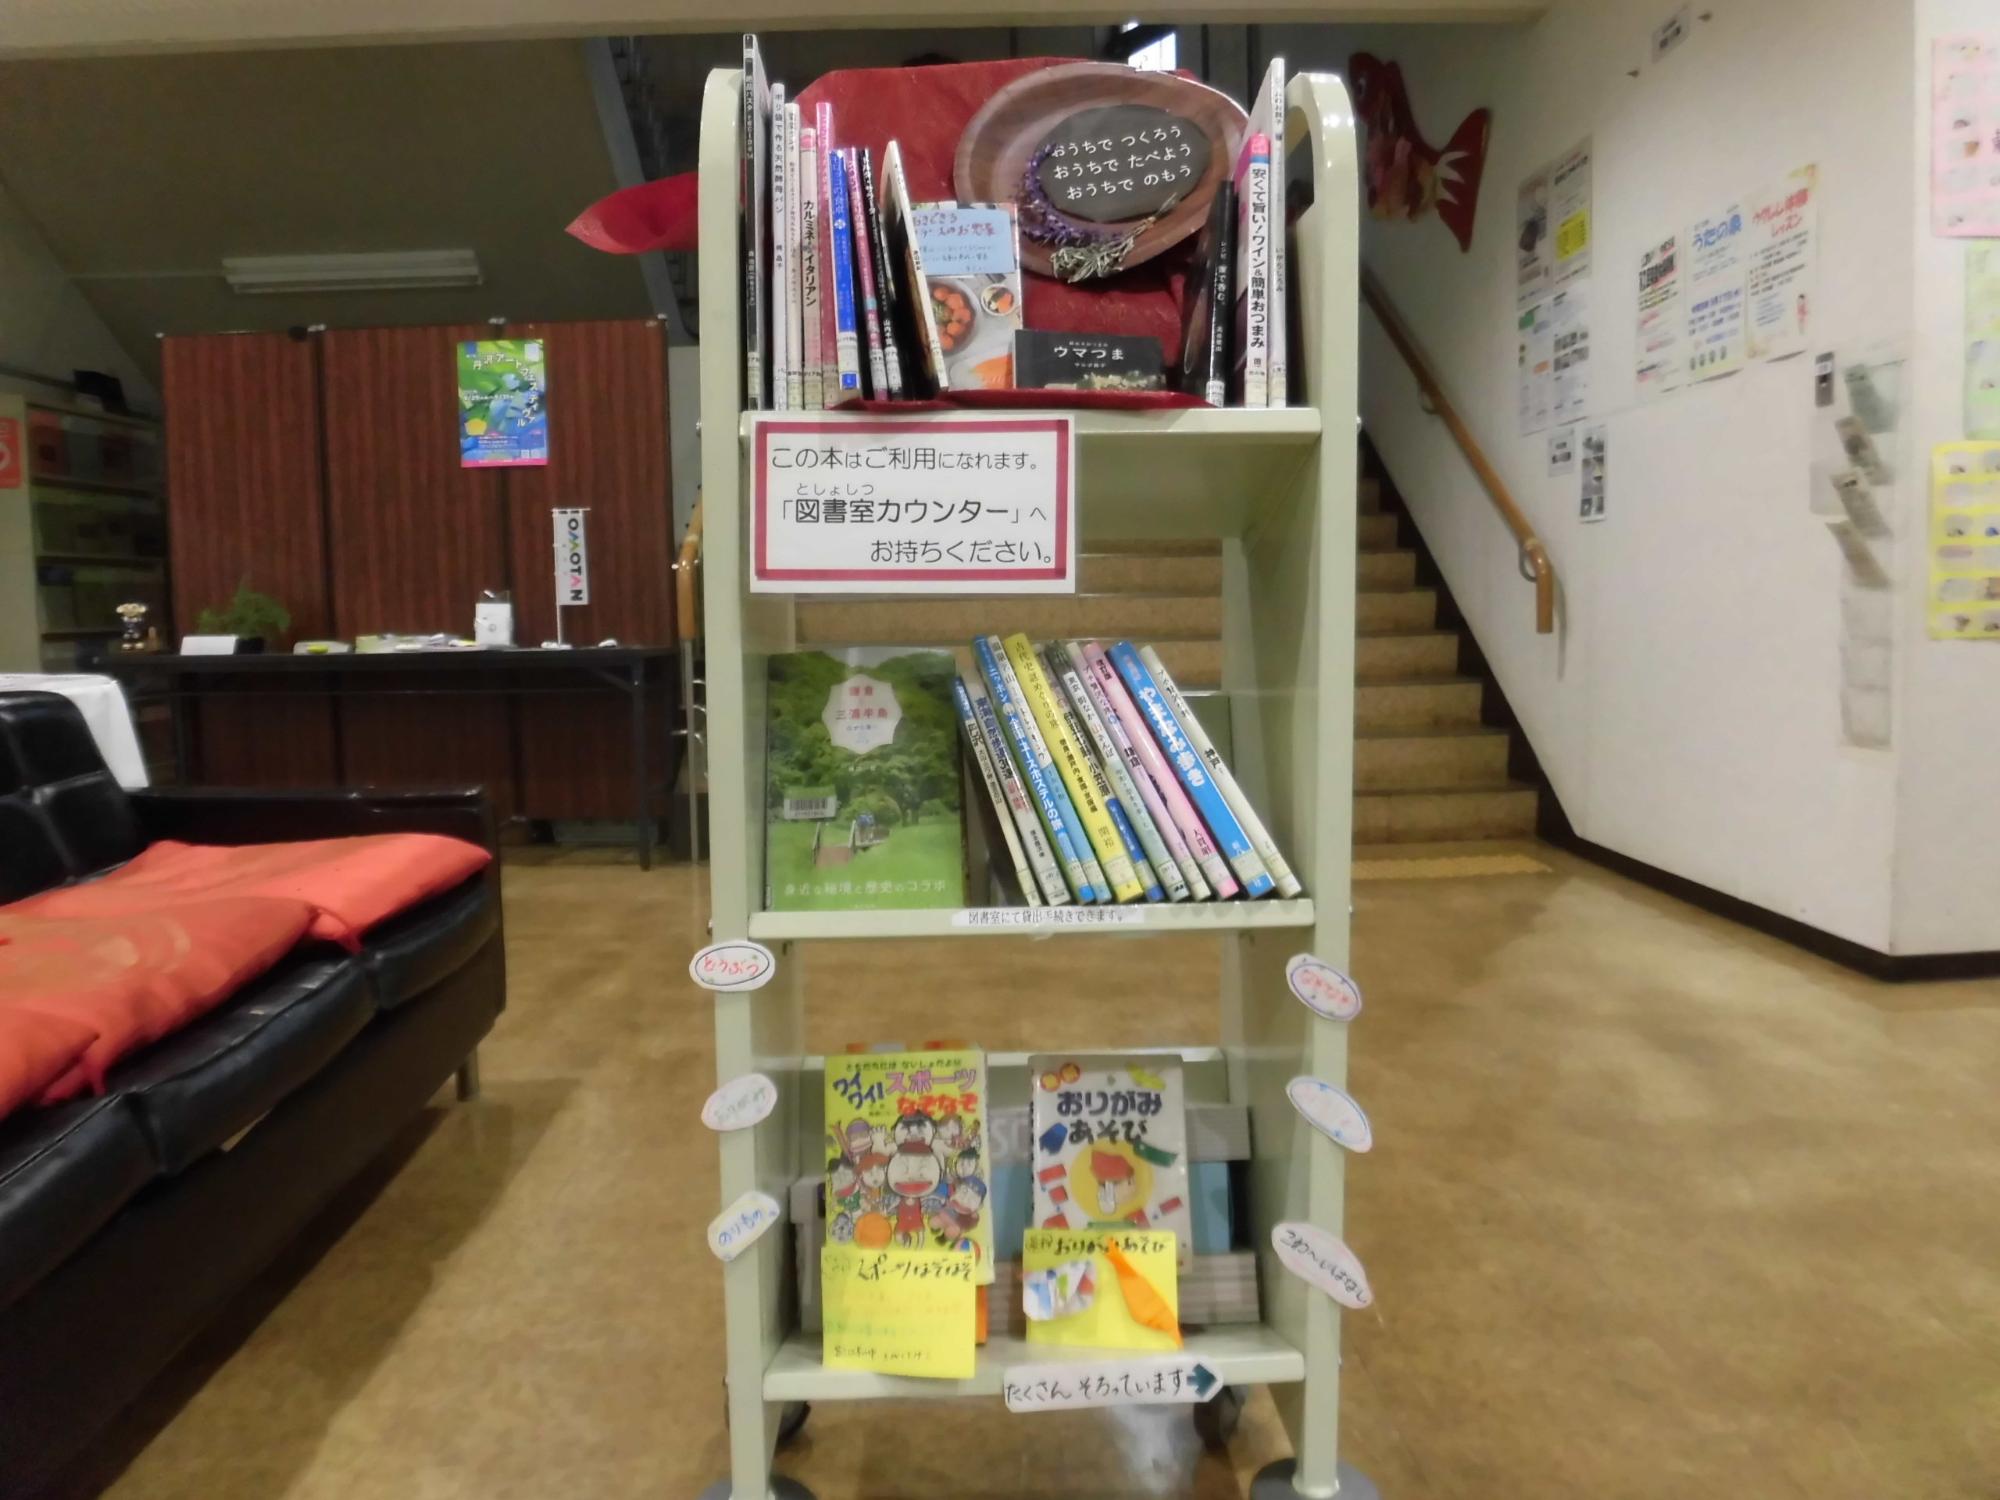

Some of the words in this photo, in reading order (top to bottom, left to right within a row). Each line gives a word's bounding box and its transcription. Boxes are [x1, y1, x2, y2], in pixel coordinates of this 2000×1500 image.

[1052, 139, 1113, 157] おうちで
[1121, 126, 1181, 147] つくろう
[1054, 159, 1119, 179] おうちで
[1127, 144, 1191, 169] たべよう
[1067, 178, 1133, 200] おうちで
[1144, 165, 1191, 186] のもう
[804, 254, 817, 307] イタリアン
[1053, 346, 1124, 361] ウマつま
[772, 446, 1038, 470] この本はご利用になれます。
[796, 482, 875, 496] としょしつ
[781, 498, 1047, 525] 「図書室カウンター」へ
[870, 539, 1053, 565] お持ちください。
[886, 1068, 977, 1094] スポーツ
[1057, 1090, 1163, 1117] おりがみ
[1069, 1119, 1148, 1145] あそび
[1079, 1368, 1185, 1398] そろっています
